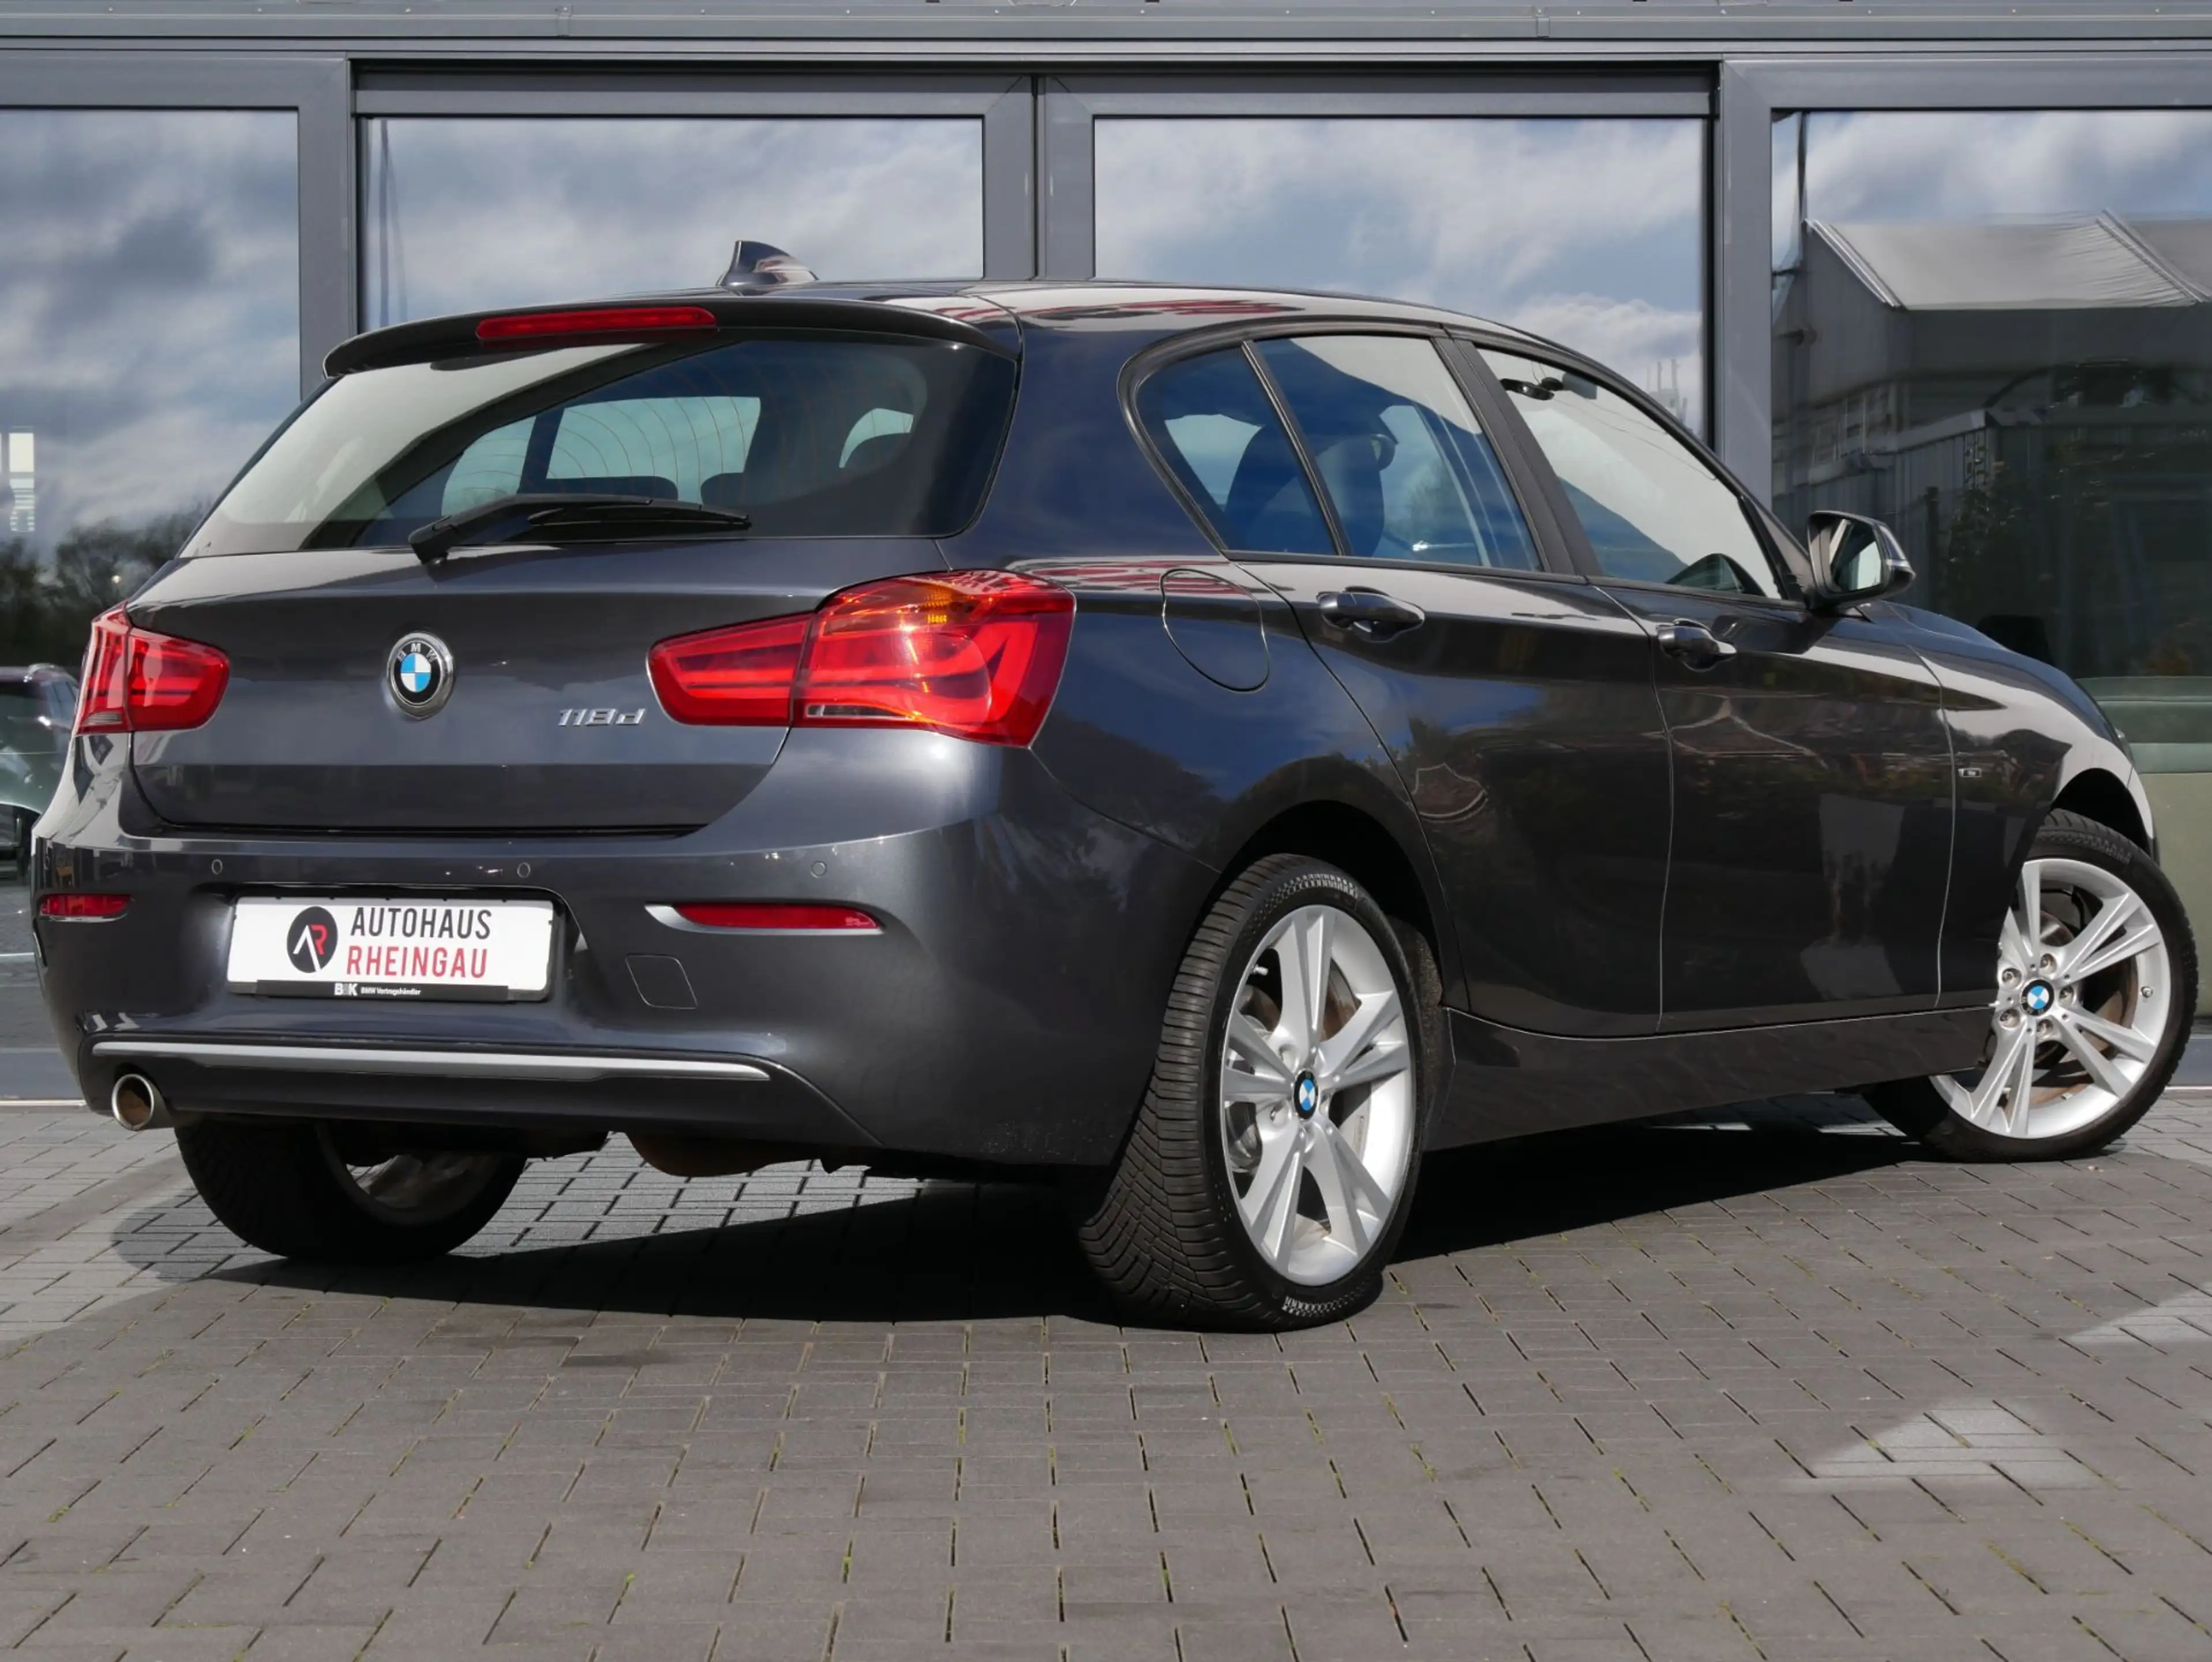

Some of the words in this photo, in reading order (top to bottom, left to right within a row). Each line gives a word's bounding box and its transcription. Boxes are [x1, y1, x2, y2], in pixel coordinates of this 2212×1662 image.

[396, 643, 438, 662] BMW
[558, 709, 645, 726] 118d
[350, 907, 492, 939] AUTOHAUS
[347, 945, 488, 978] RHEINGAU
